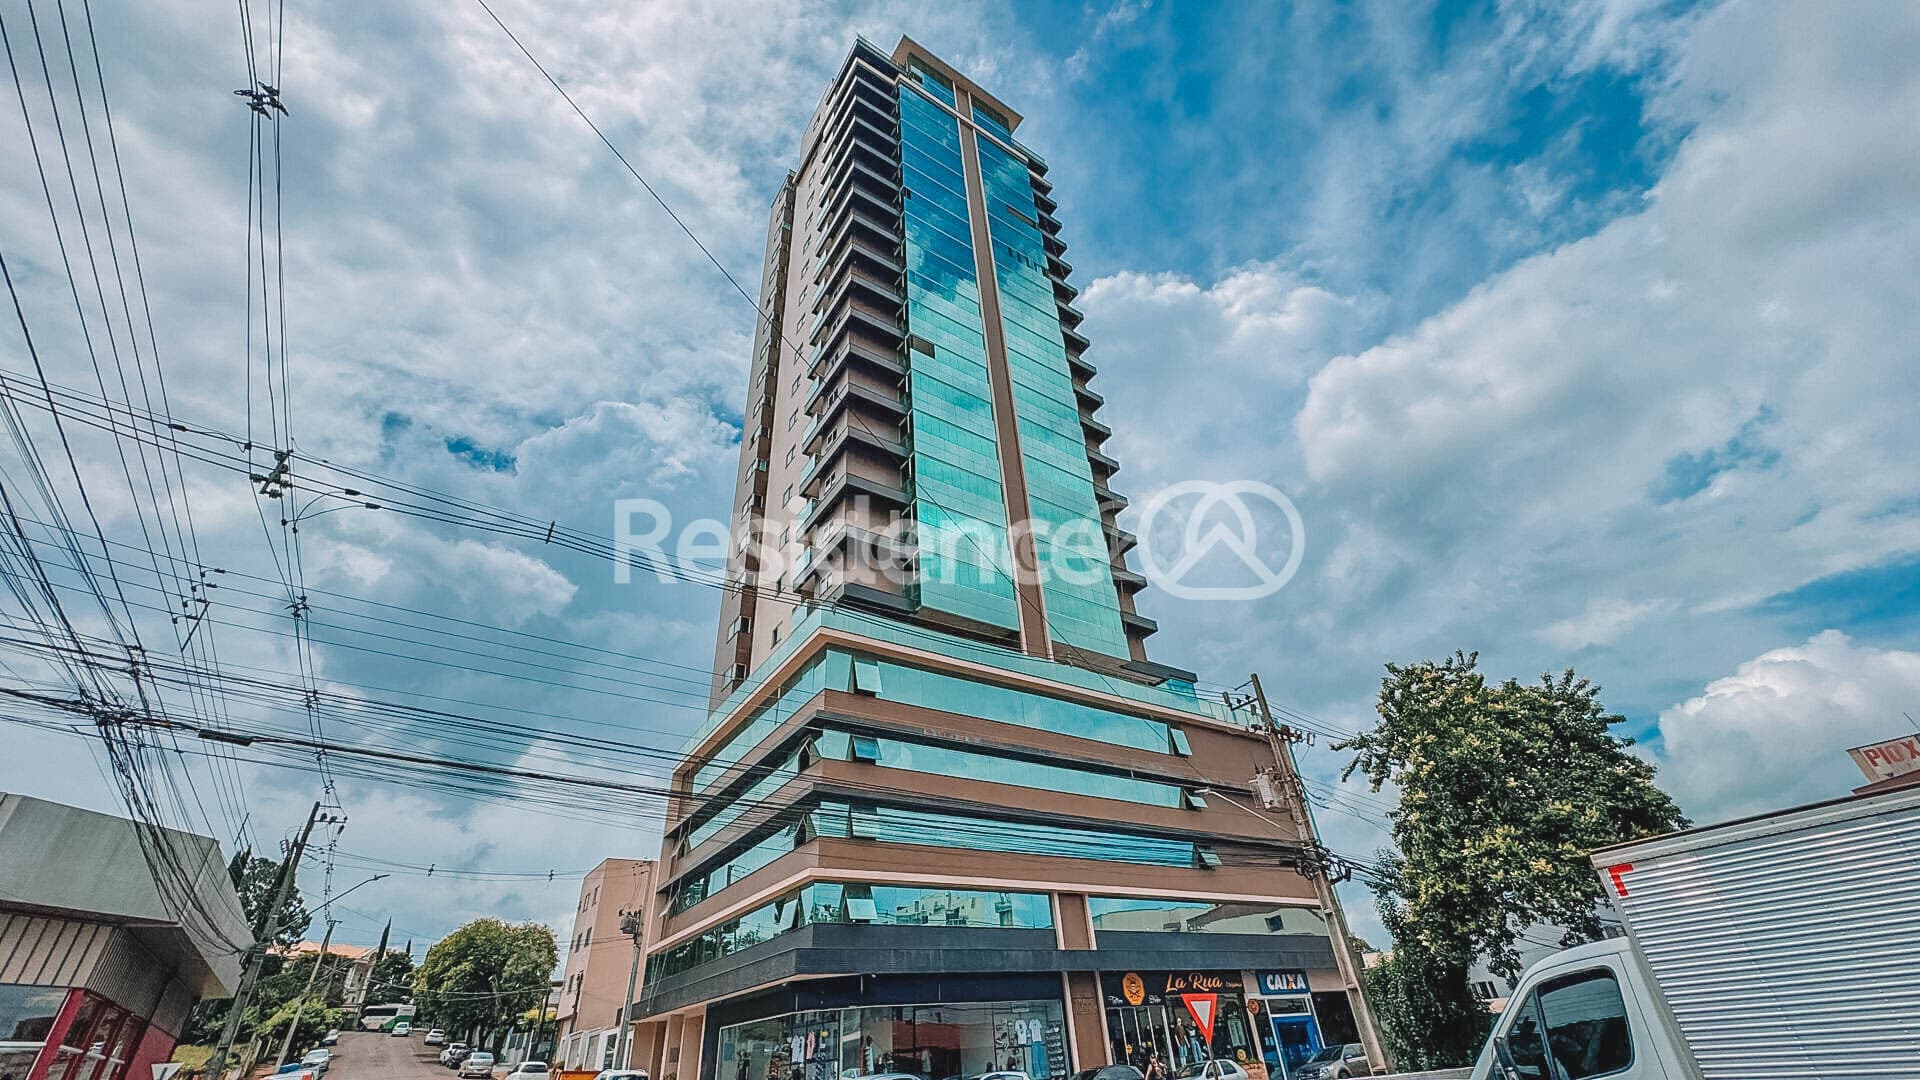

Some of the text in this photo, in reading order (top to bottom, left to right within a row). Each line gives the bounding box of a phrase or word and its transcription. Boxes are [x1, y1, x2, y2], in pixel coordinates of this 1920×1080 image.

[1165, 973, 1187, 993] La
[1188, 972, 1222, 992] Rua
[1266, 974, 1306, 990] CAIXA
